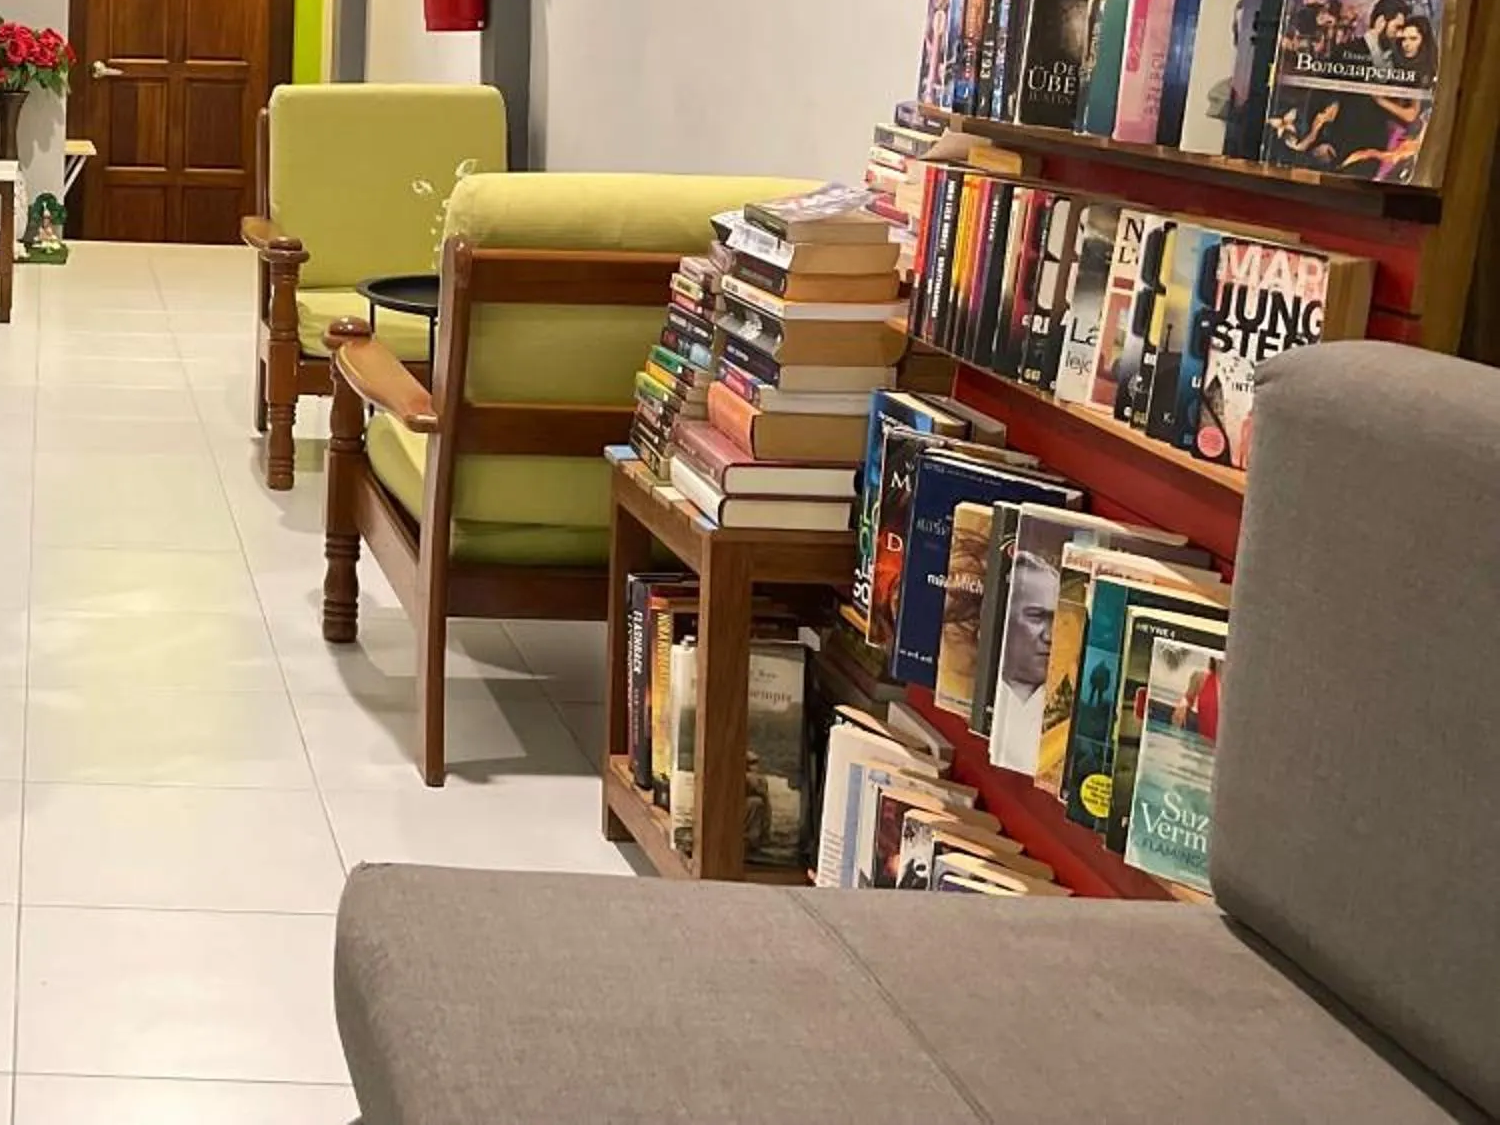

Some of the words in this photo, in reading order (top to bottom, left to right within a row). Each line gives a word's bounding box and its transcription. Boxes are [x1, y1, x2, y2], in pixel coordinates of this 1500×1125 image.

[1296, 52, 1416, 82] Володарская
[1215, 281, 1322, 346] JUNG
[1140, 801, 1207, 854] Verm
